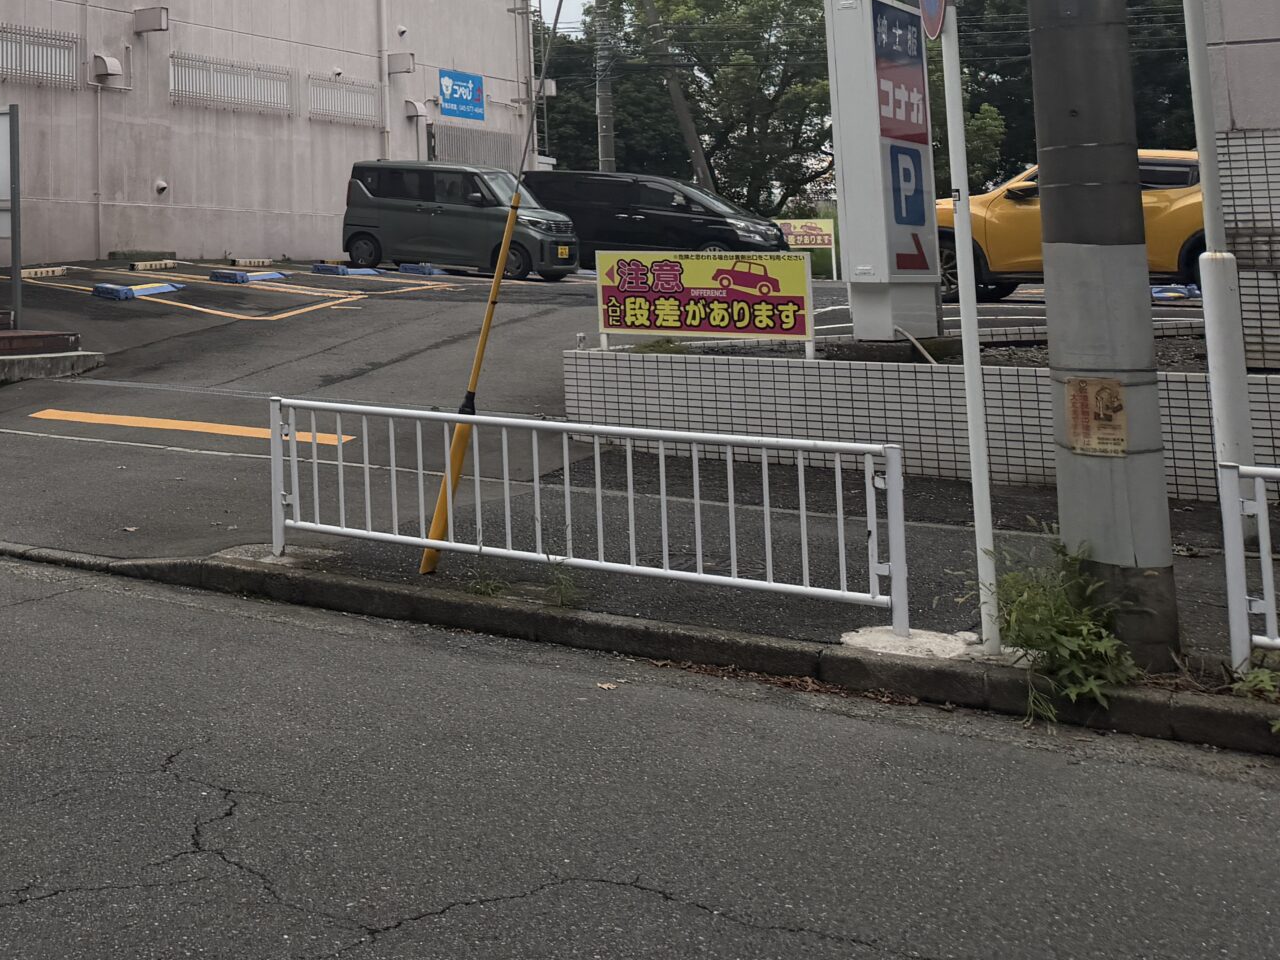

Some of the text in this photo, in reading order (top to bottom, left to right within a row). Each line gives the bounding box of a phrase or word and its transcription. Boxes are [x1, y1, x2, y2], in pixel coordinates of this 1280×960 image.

[877, 14, 918, 56] 紳士服
[880, 78, 923, 124] コナカ
[898, 153, 915, 218] P
[617, 260, 684, 294] 注意
[690, 289, 727, 297] DIFFERENCE
[608, 297, 621, 327] 入口に
[623, 296, 800, 330] 段差があります
